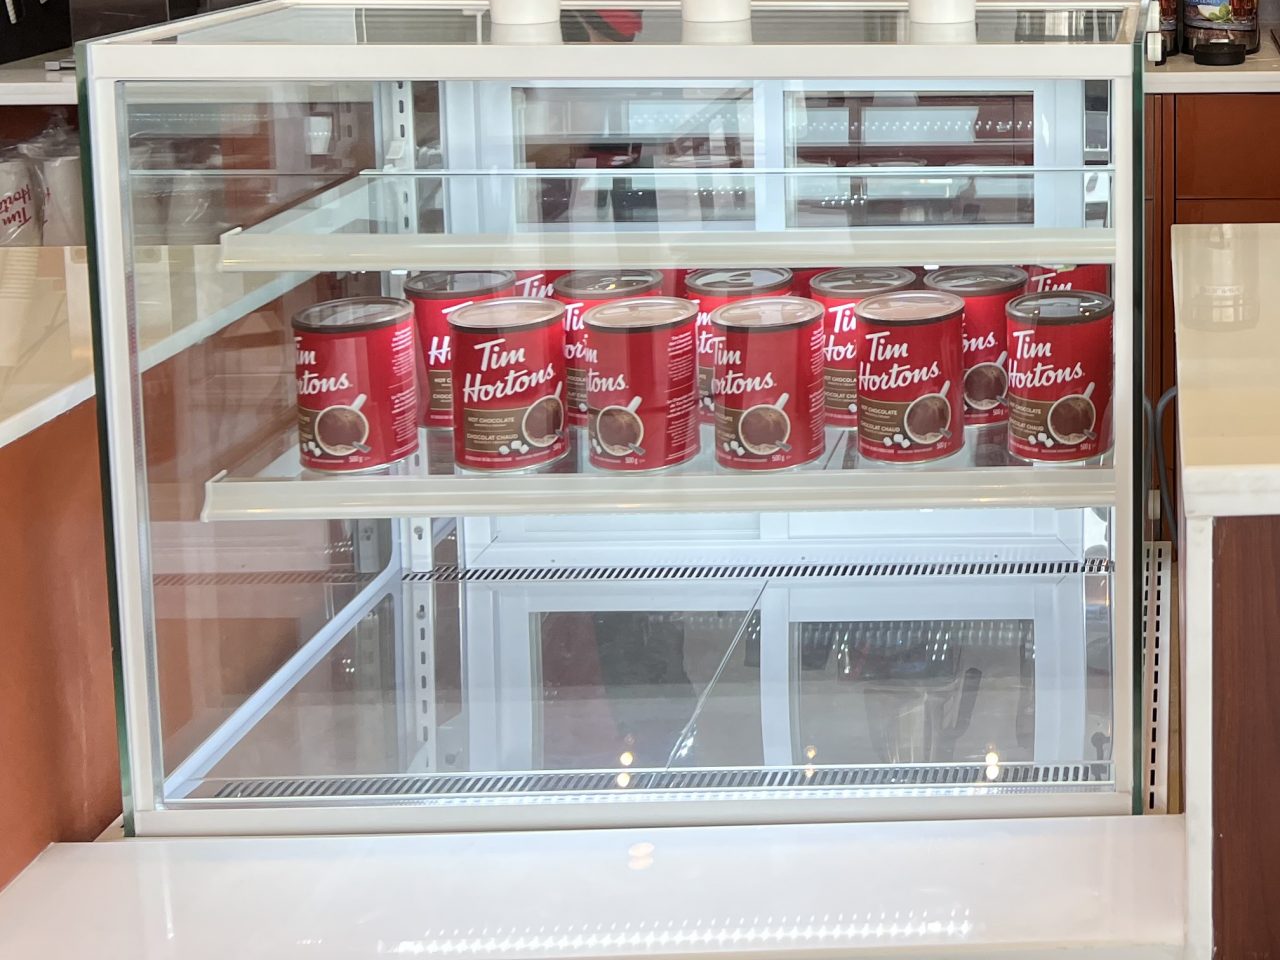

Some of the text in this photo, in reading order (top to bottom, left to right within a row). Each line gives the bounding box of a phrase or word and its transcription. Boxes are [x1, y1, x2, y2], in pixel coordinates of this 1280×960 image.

[2, 206, 32, 228] Tim
[474, 338, 526, 372] Tim
[713, 336, 742, 365] Tim
[865, 331, 909, 362] Tim
[1012, 330, 1052, 360] Tim
[297, 369, 349, 395] tons
[462, 362, 556, 404] Hortons
[858, 361, 940, 392] Hortons
[1008, 358, 1082, 390] Hortons
